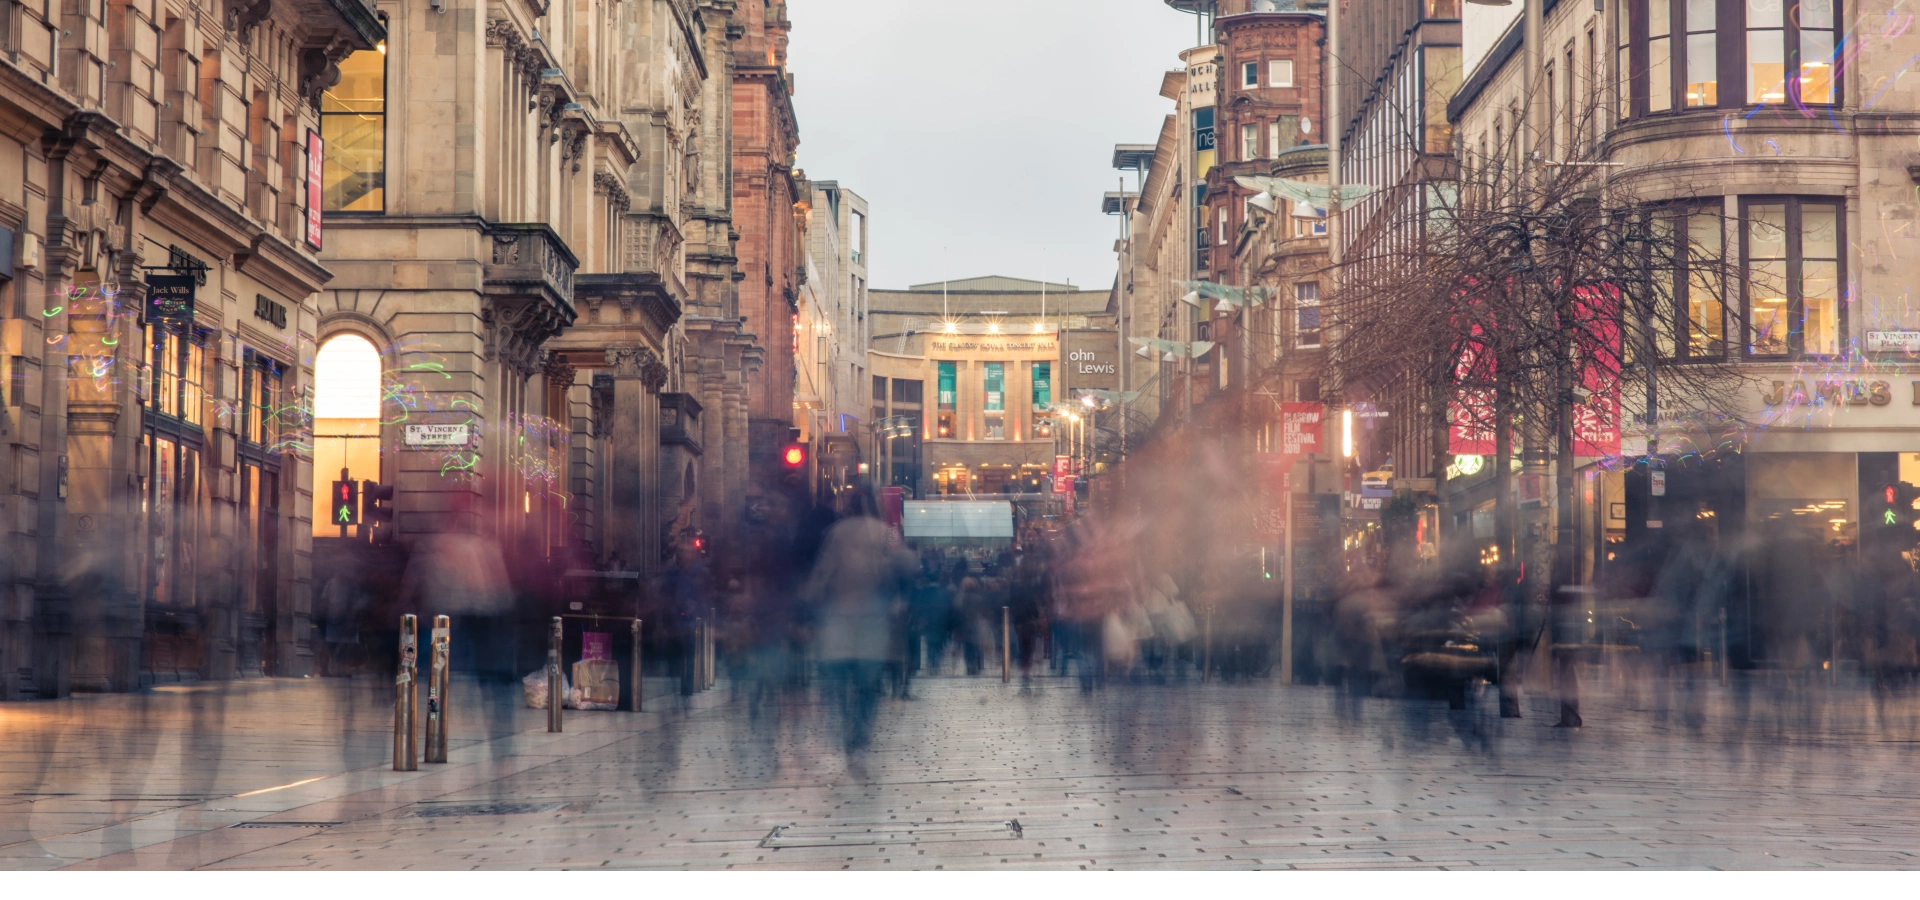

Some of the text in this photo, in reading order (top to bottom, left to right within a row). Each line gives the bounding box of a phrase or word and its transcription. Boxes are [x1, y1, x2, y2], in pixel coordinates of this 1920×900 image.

[1199, 131, 1215, 148] ne
[152, 286, 190, 295] Jack Wills
[1069, 348, 1095, 361] ohn
[1079, 361, 1115, 374] Lewis
[1763, 380, 1892, 406] JAMES
[1283, 412, 1319, 423] GLASGOW
[410, 425, 464, 433] ST. VINCENT
[1283, 423, 1301, 433] FILM
[1581, 406, 1597, 441] AKE
[421, 433, 453, 441] STREET
[1283, 433, 1316, 444] FESTIVAL
[1283, 443, 1301, 454] 2019
